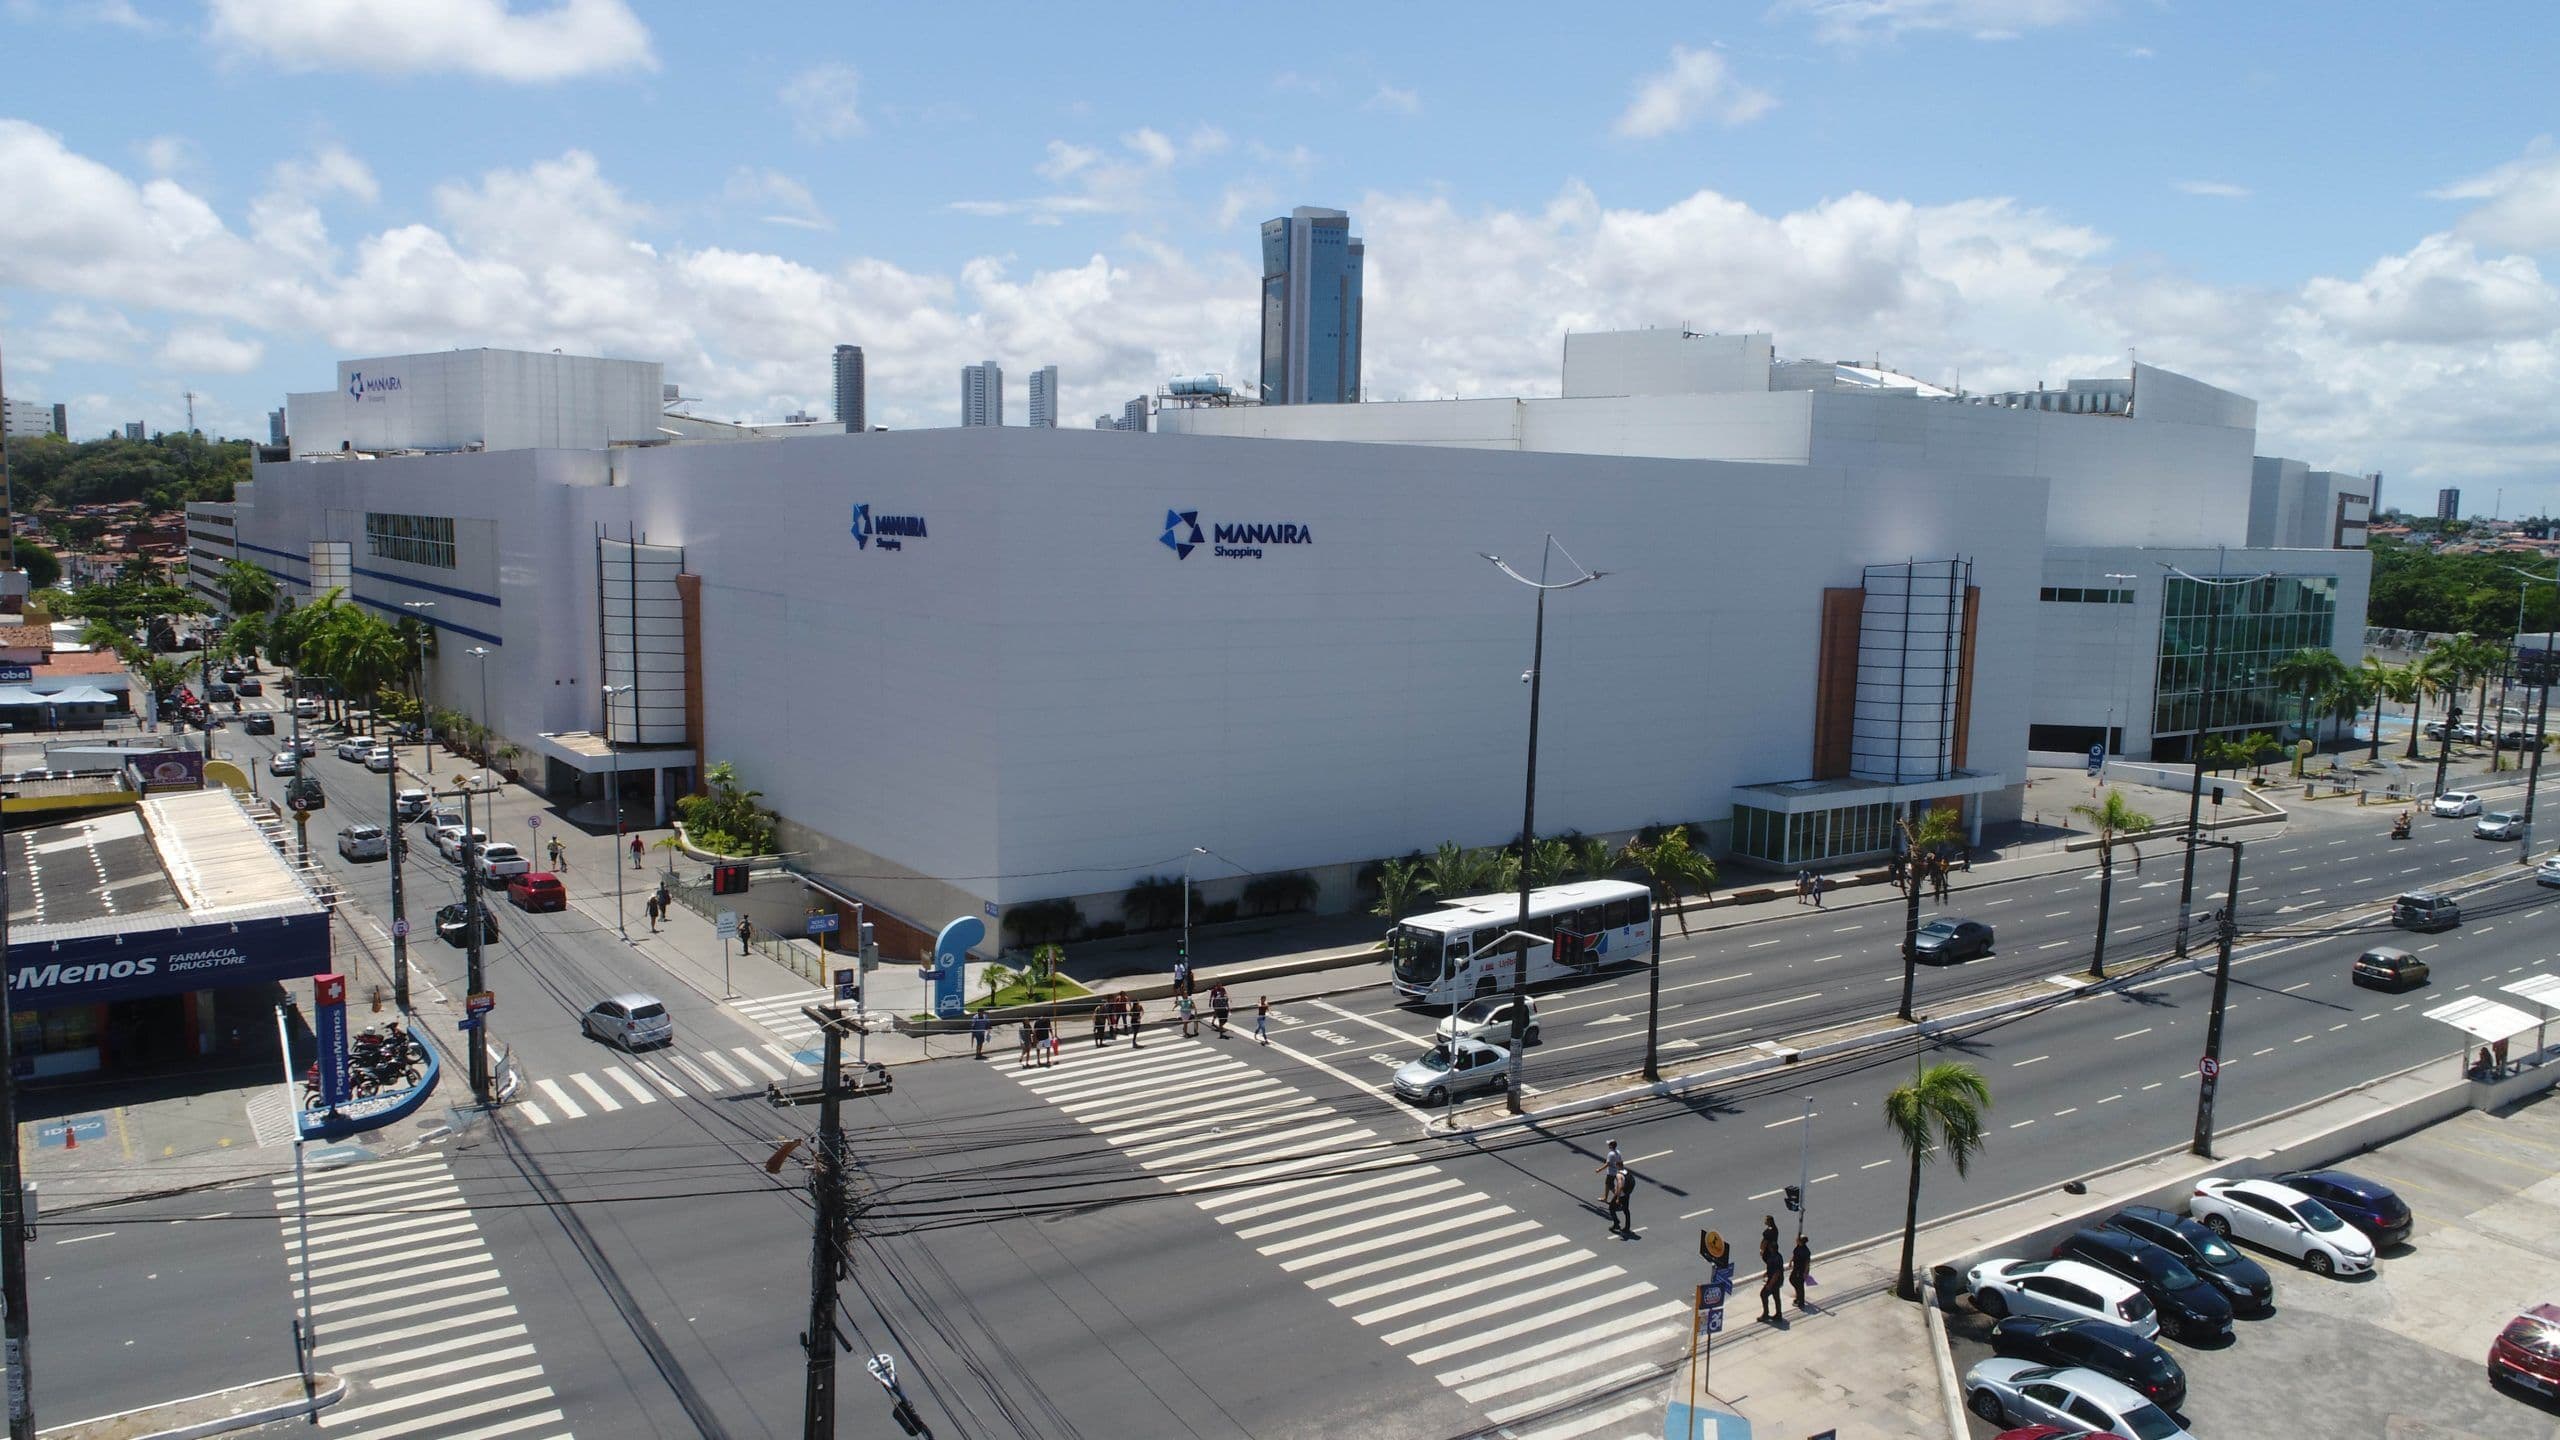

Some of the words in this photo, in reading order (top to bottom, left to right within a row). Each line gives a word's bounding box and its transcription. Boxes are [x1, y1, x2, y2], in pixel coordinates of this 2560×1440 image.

[1214, 523, 1312, 544] MANAIRA
[1214, 545, 1262, 559] Shopping
[0, 669, 30, 680] obel
[168, 948, 236, 963] FARMÁCIA
[168, 955, 248, 972] DRUGSTORE
[333, 1009, 345, 1096] PagueMenos
